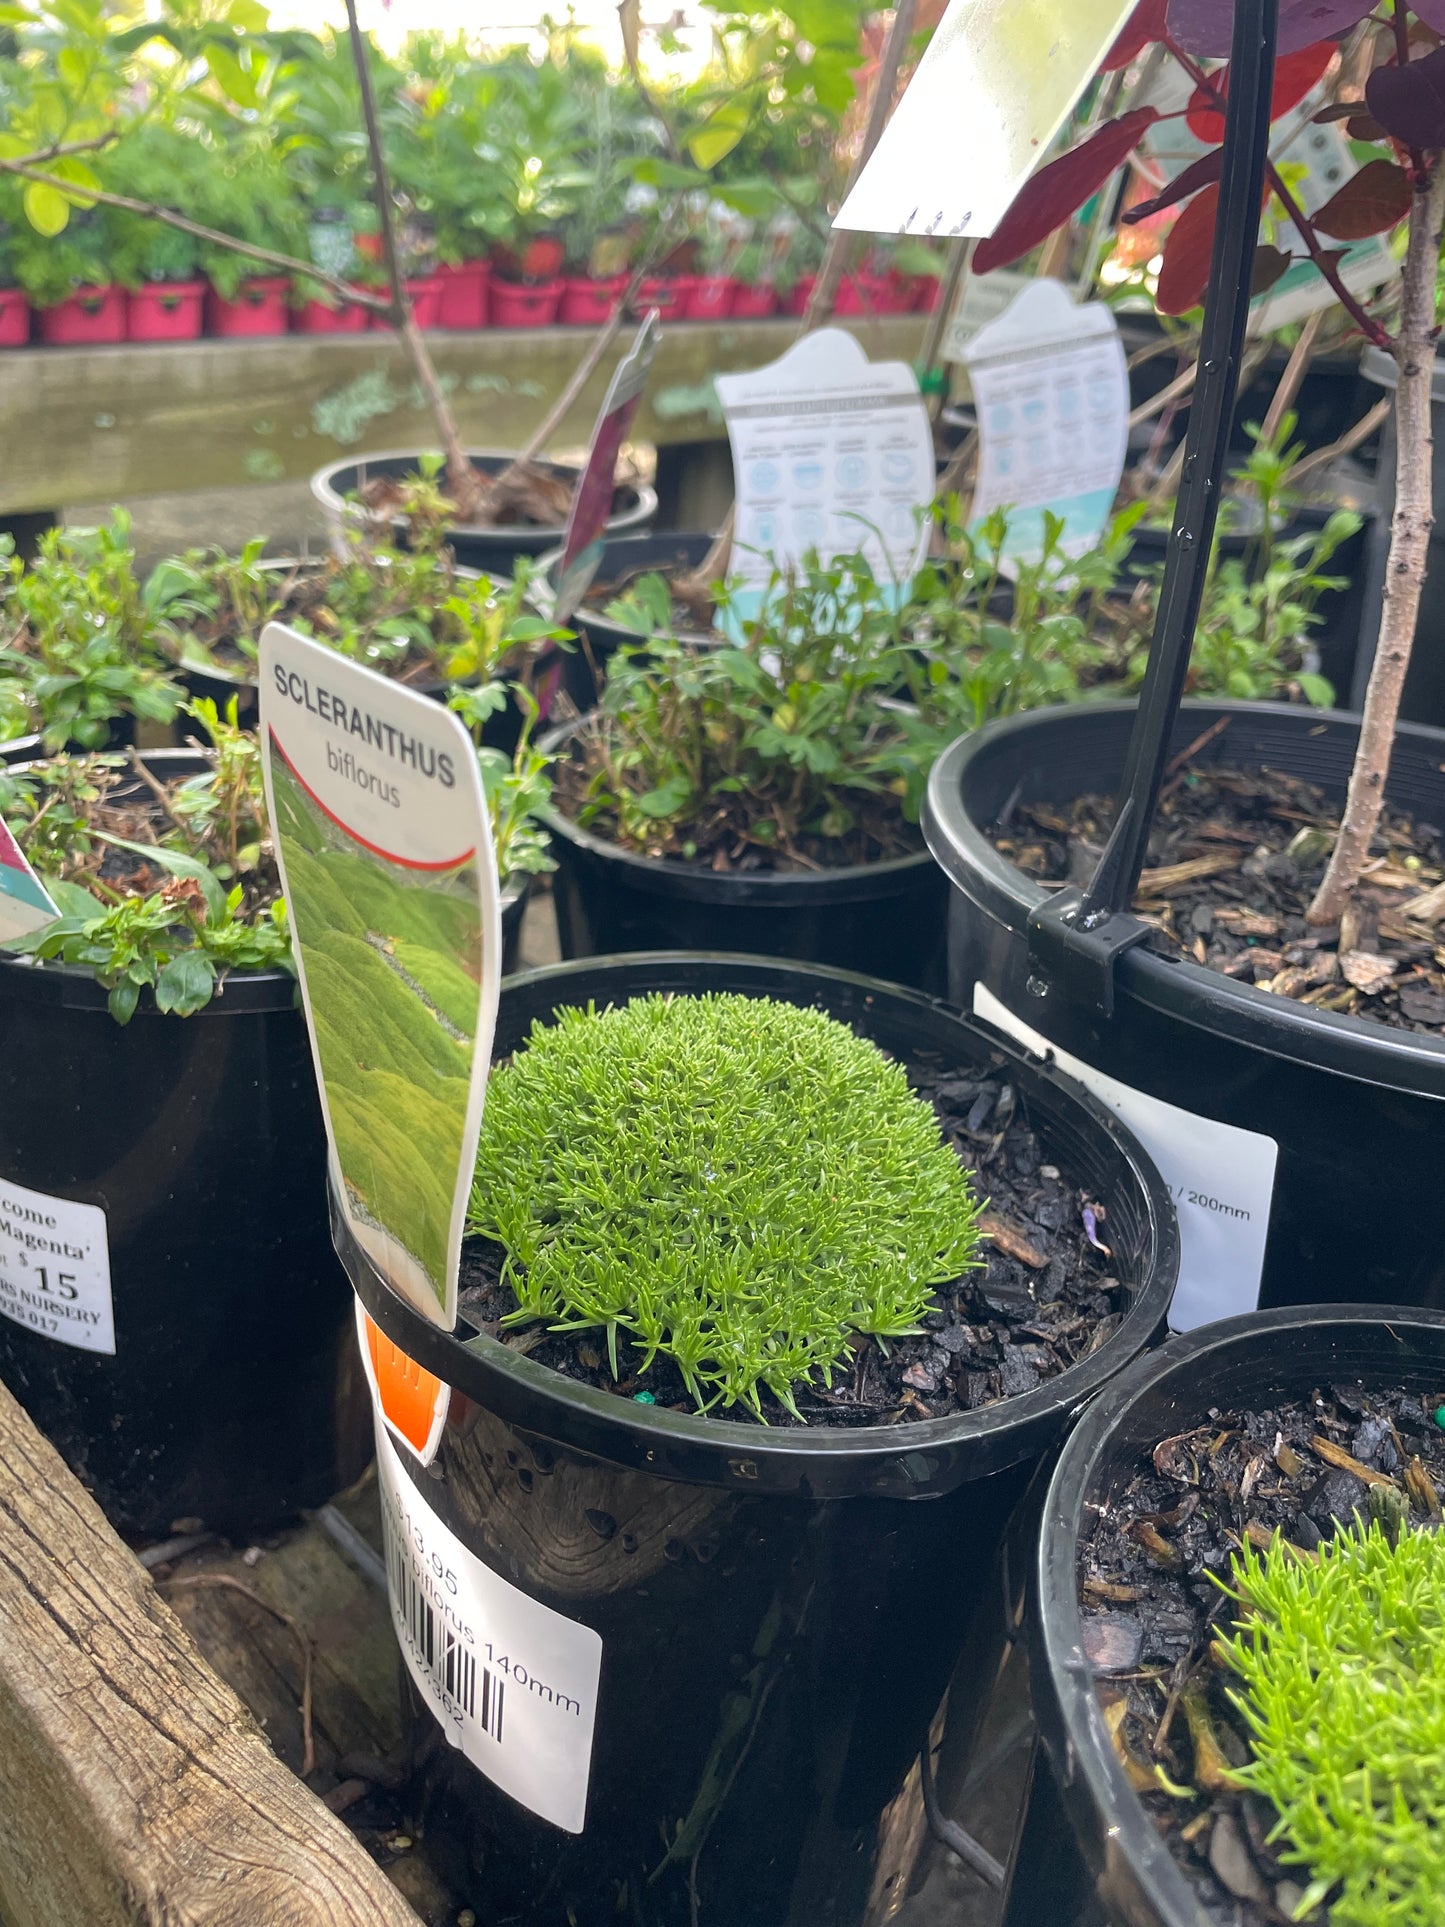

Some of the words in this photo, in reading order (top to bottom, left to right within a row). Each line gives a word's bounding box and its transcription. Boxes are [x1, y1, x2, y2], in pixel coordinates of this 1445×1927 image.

[274, 664, 457, 789] SCLERANTHUS
[326, 740, 401, 809] biflorus
[0, 1198, 57, 1229] come
[1187, 1190, 1251, 1221] 200mm
[34, 1265, 80, 1301] 15
[20, 1288, 102, 1326] NURSERY
[411, 1553, 475, 1645] biflorus
[484, 1643, 582, 1716] 140mm
